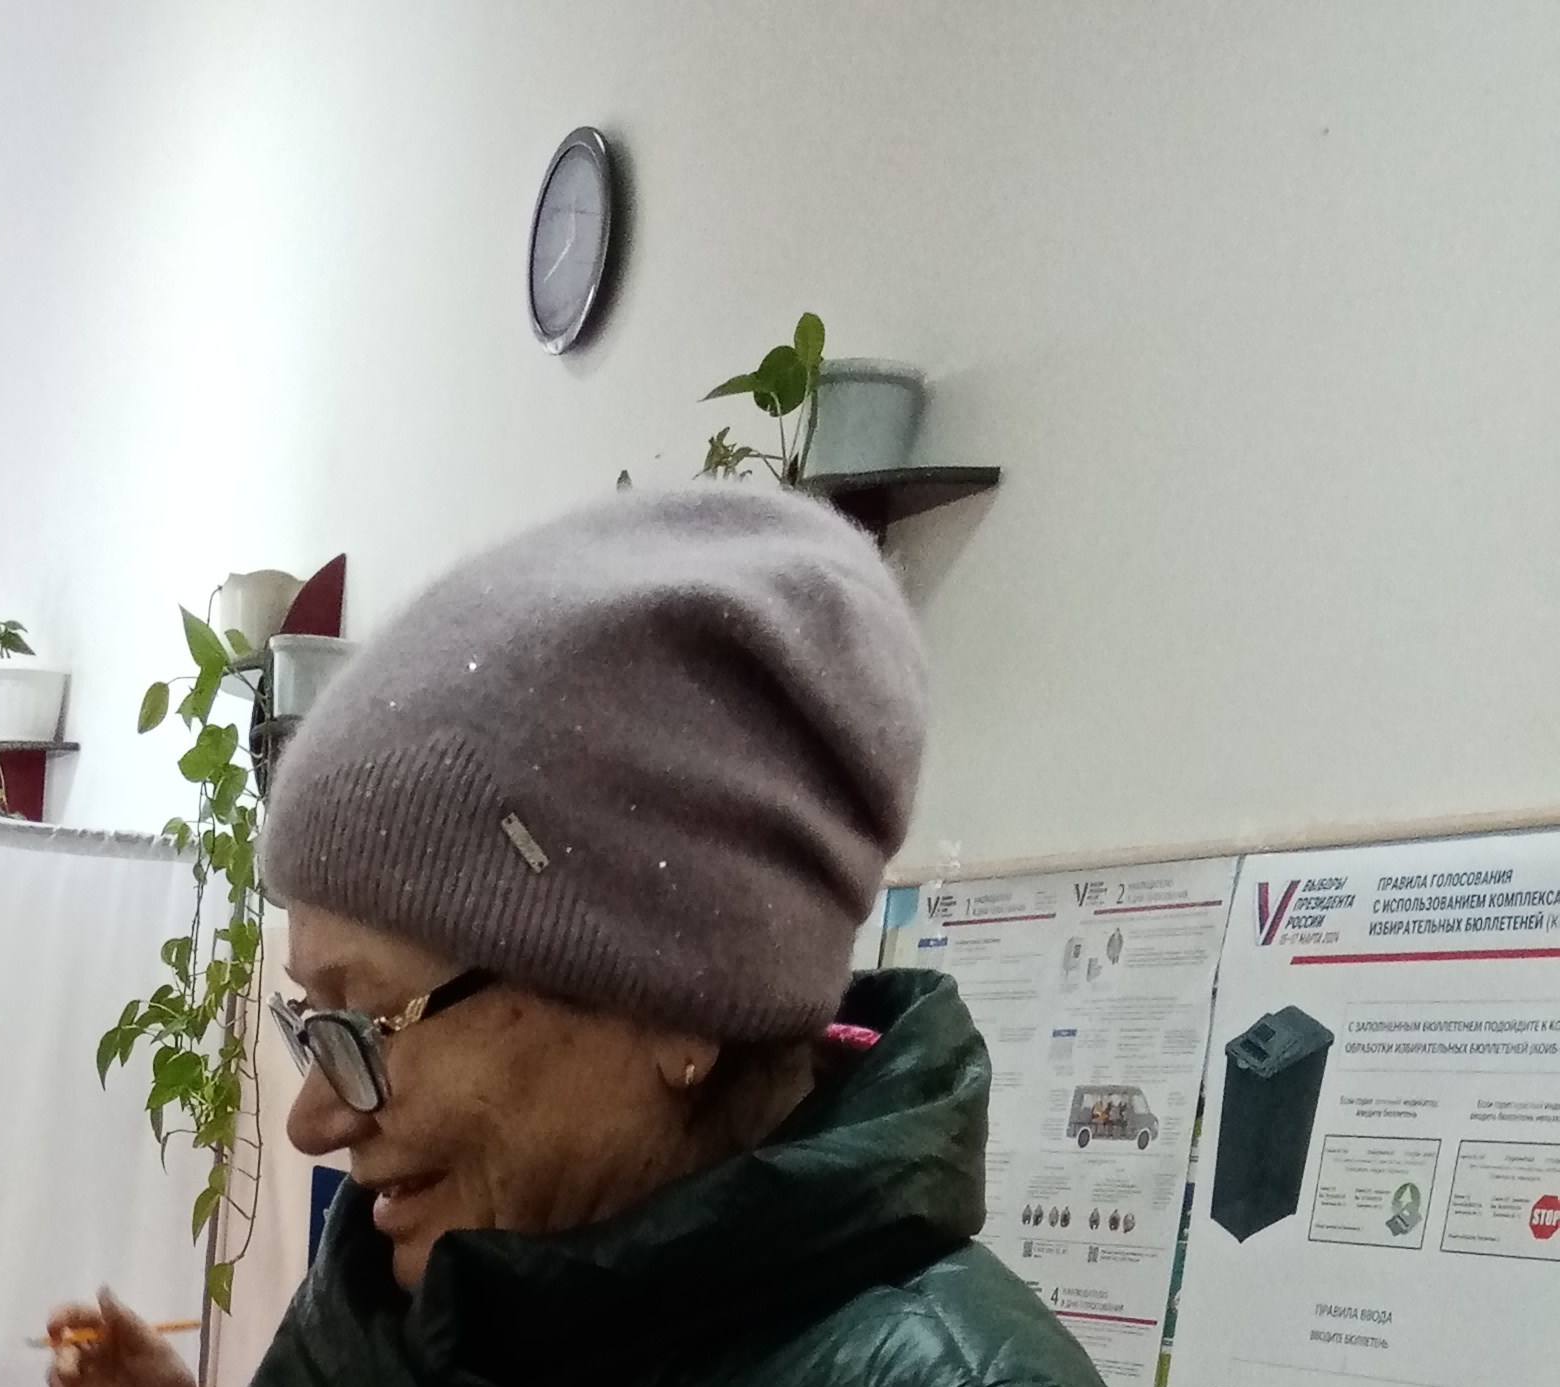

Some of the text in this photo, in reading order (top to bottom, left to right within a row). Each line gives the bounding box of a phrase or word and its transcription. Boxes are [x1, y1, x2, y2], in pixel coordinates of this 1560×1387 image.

[1302, 876, 1348, 892] ВЫБОРЫ
[1376, 869, 1513, 891] ПРАВИЛА ГОЛОСОВАНИЯ
[1293, 895, 1356, 912] ПРЕЗИДЕНТА
[1373, 900, 1380, 913] С
[1382, 894, 1486, 913] ИСПОЛЬЗОВАНИЕМ
[1285, 914, 1326, 929] РОССИИ
[1369, 917, 1462, 937] ИЗБИРАТЕЛЬНЫХ
[1465, 911, 1544, 932] БЮЛЛЕТЕНЕЙ
[1356, 1021, 1421, 1032] ЗАПОЛНЕННЫМ
[1422, 1020, 1483, 1032] БЮЛЛЕТЕНЕМ
[1484, 1019, 1539, 1033] ПОДОЙДИТЕ
[1345, 1042, 1393, 1053] ОБРАБОТКИ
[1394, 1042, 1467, 1054] ИЗБИРАТЕЛЬНЫХ
[1468, 1041, 1528, 1054] БЮЛЛЕТЕНЕЙ
[1050, 1287, 1059, 1306] 4
[1315, 1304, 1393, 1325] ПРАВИЛА ВВОДА
[1310, 1330, 1389, 1349] ВВОДИТЕ БЮЛЛЕТЕНЬ
